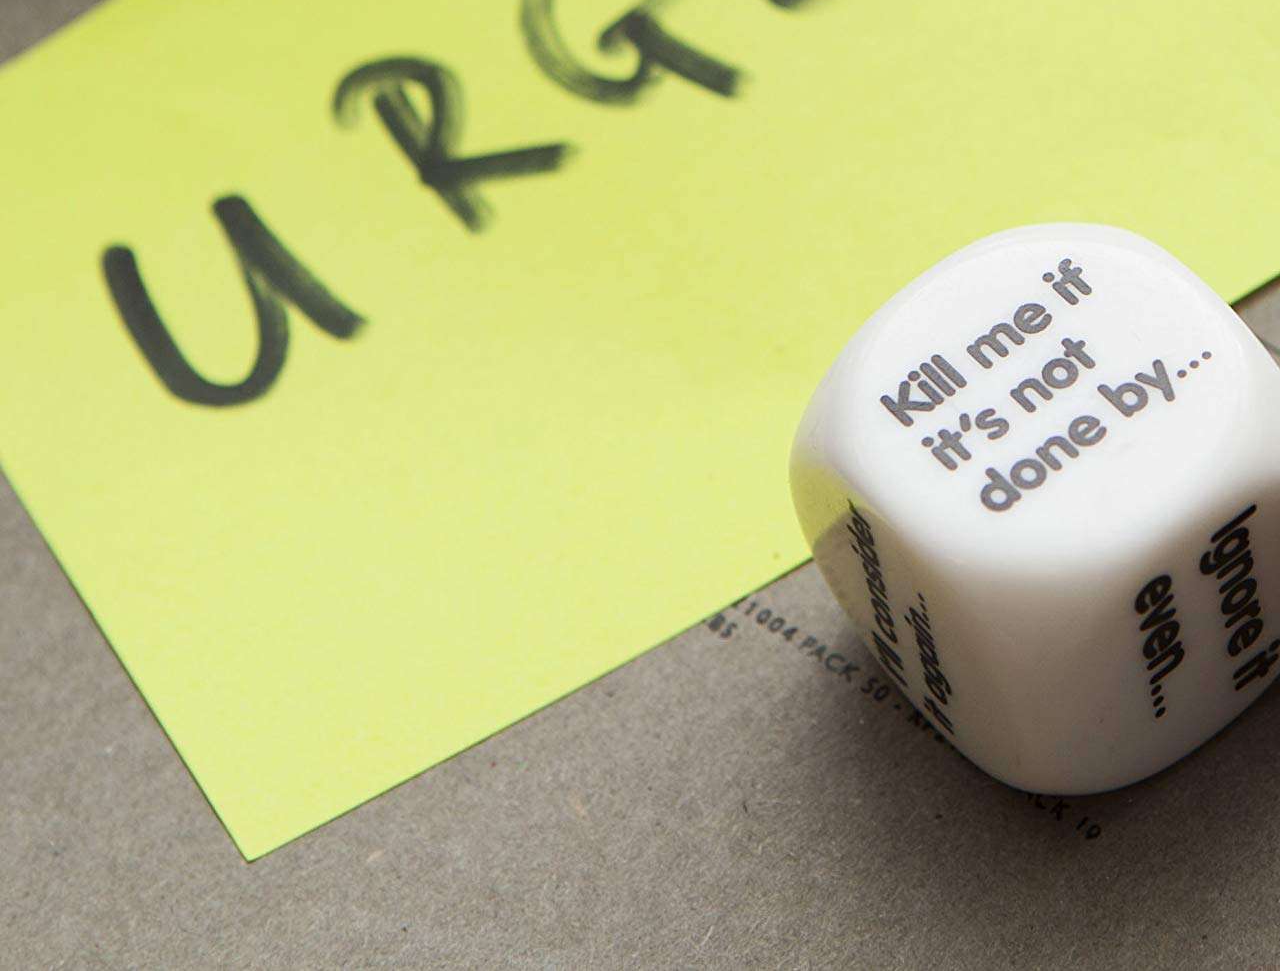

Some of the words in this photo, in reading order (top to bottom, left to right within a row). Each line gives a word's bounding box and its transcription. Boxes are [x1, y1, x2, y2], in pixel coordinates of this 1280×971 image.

[880, 354, 966, 427] Kill
[967, 302, 1052, 369] me
[1043, 258, 1092, 305] if
[921, 408, 1009, 470] it's
[1010, 338, 1095, 412] not
[980, 415, 1106, 512] done
[1098, 351, 1211, 417] by...
[742, 601, 798, 641] 1004
[800, 635, 860, 682] PACK
[846, 499, 898, 644] consider
[1199, 504, 1263, 657] Ignore
[1233, 638, 1280, 690] it
[925, 696, 954, 735] it
[1134, 574, 1186, 718] even...
